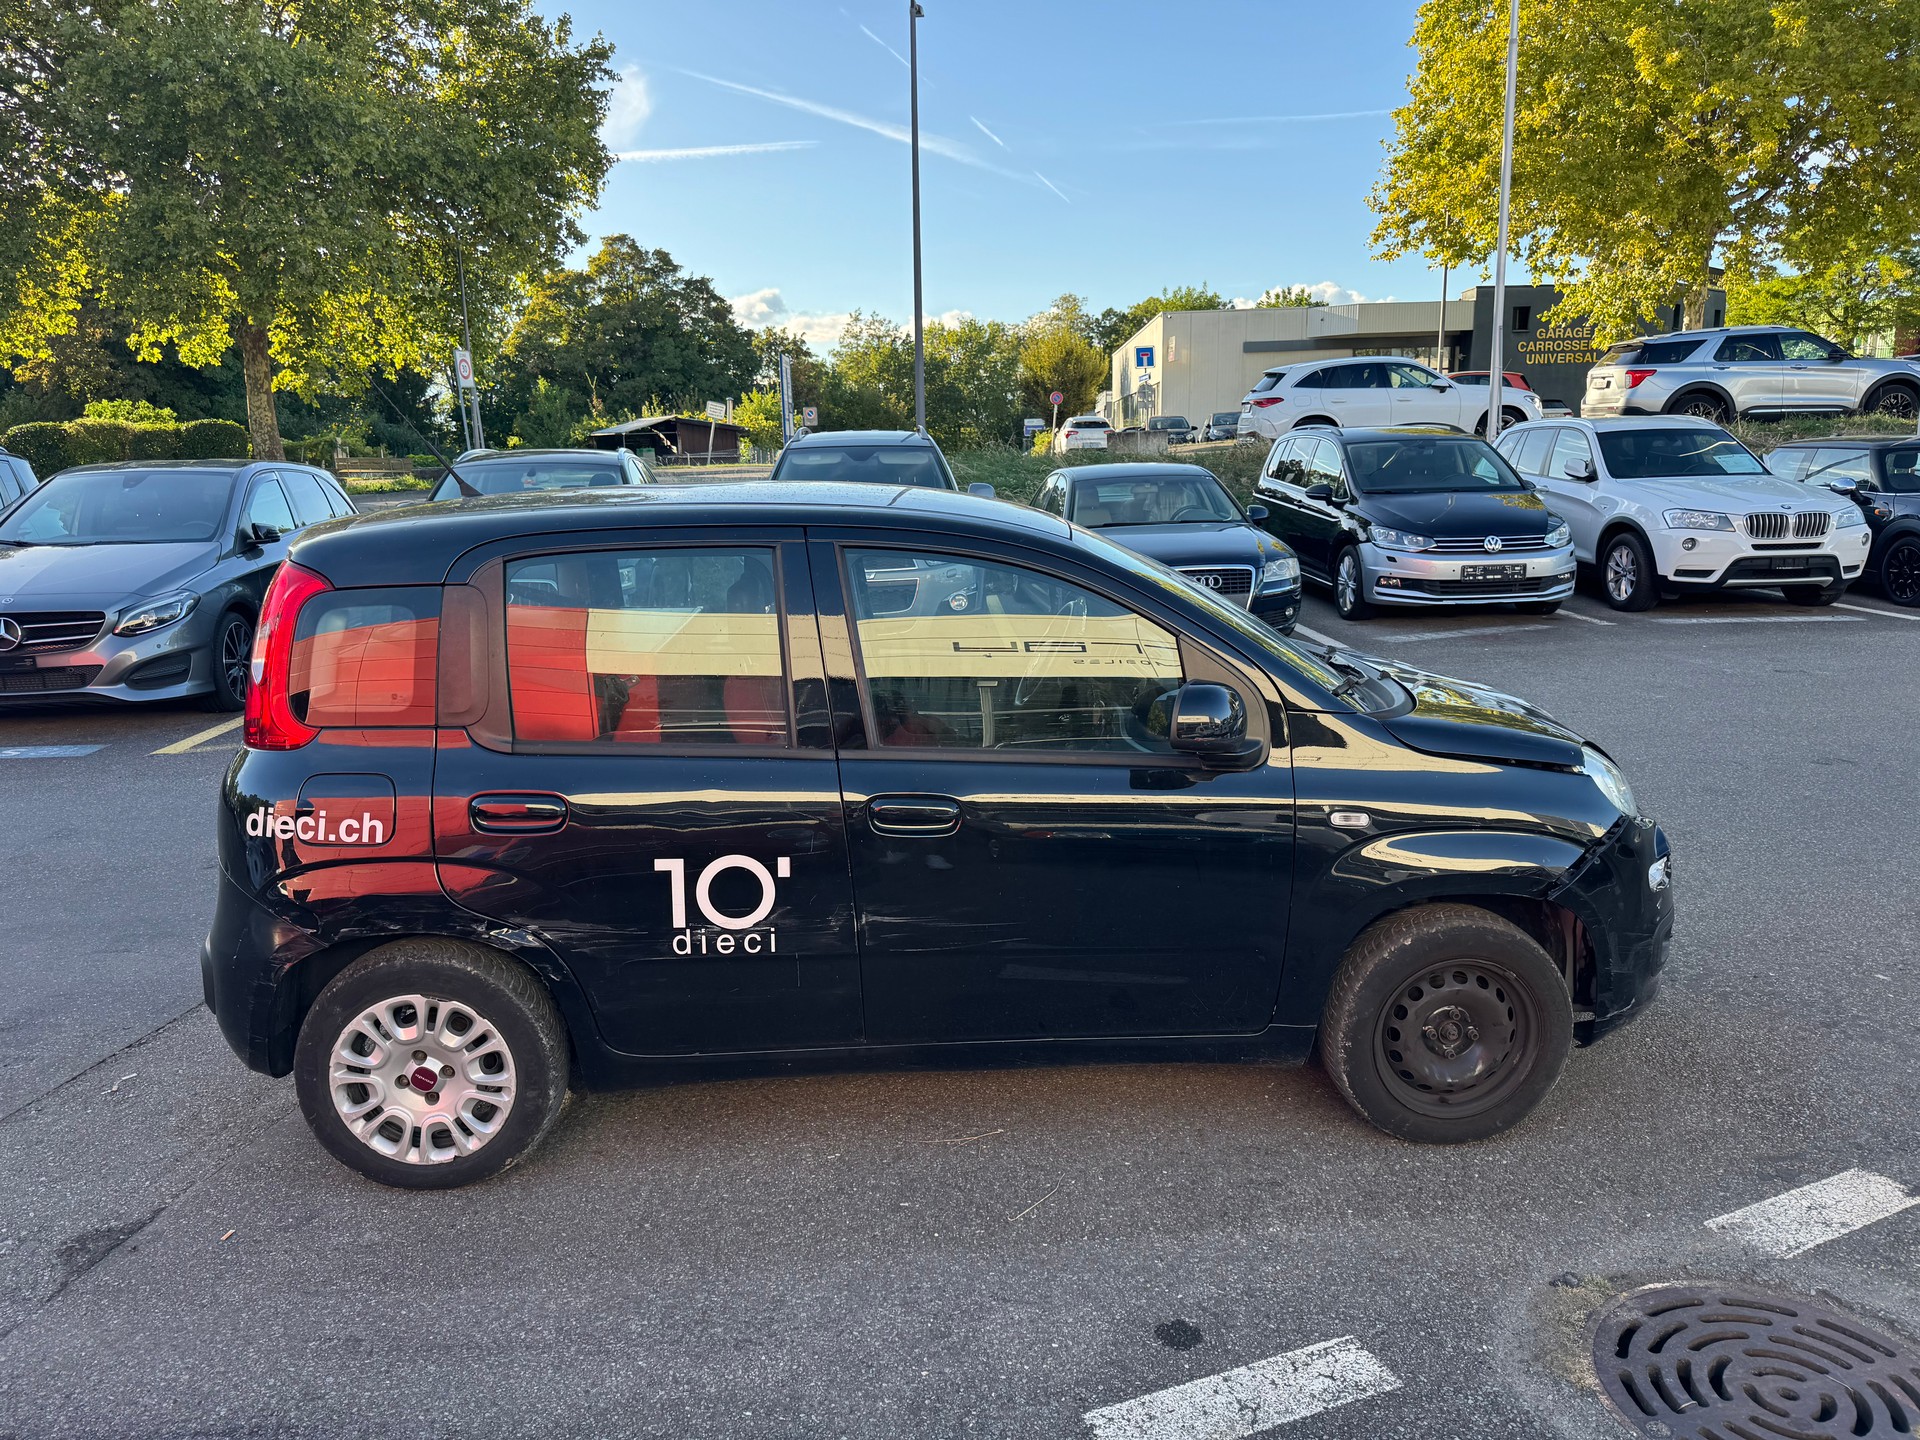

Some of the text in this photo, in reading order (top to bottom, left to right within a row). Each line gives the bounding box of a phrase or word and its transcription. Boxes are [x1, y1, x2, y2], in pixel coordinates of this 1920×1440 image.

[1536, 327, 1591, 338] GARAGE
[1517, 340, 1594, 352] CARROSSE
[1526, 352, 1600, 364] UNIVERSAL
[246, 806, 384, 844] dieci.ch
[672, 927, 776, 955] dieci
